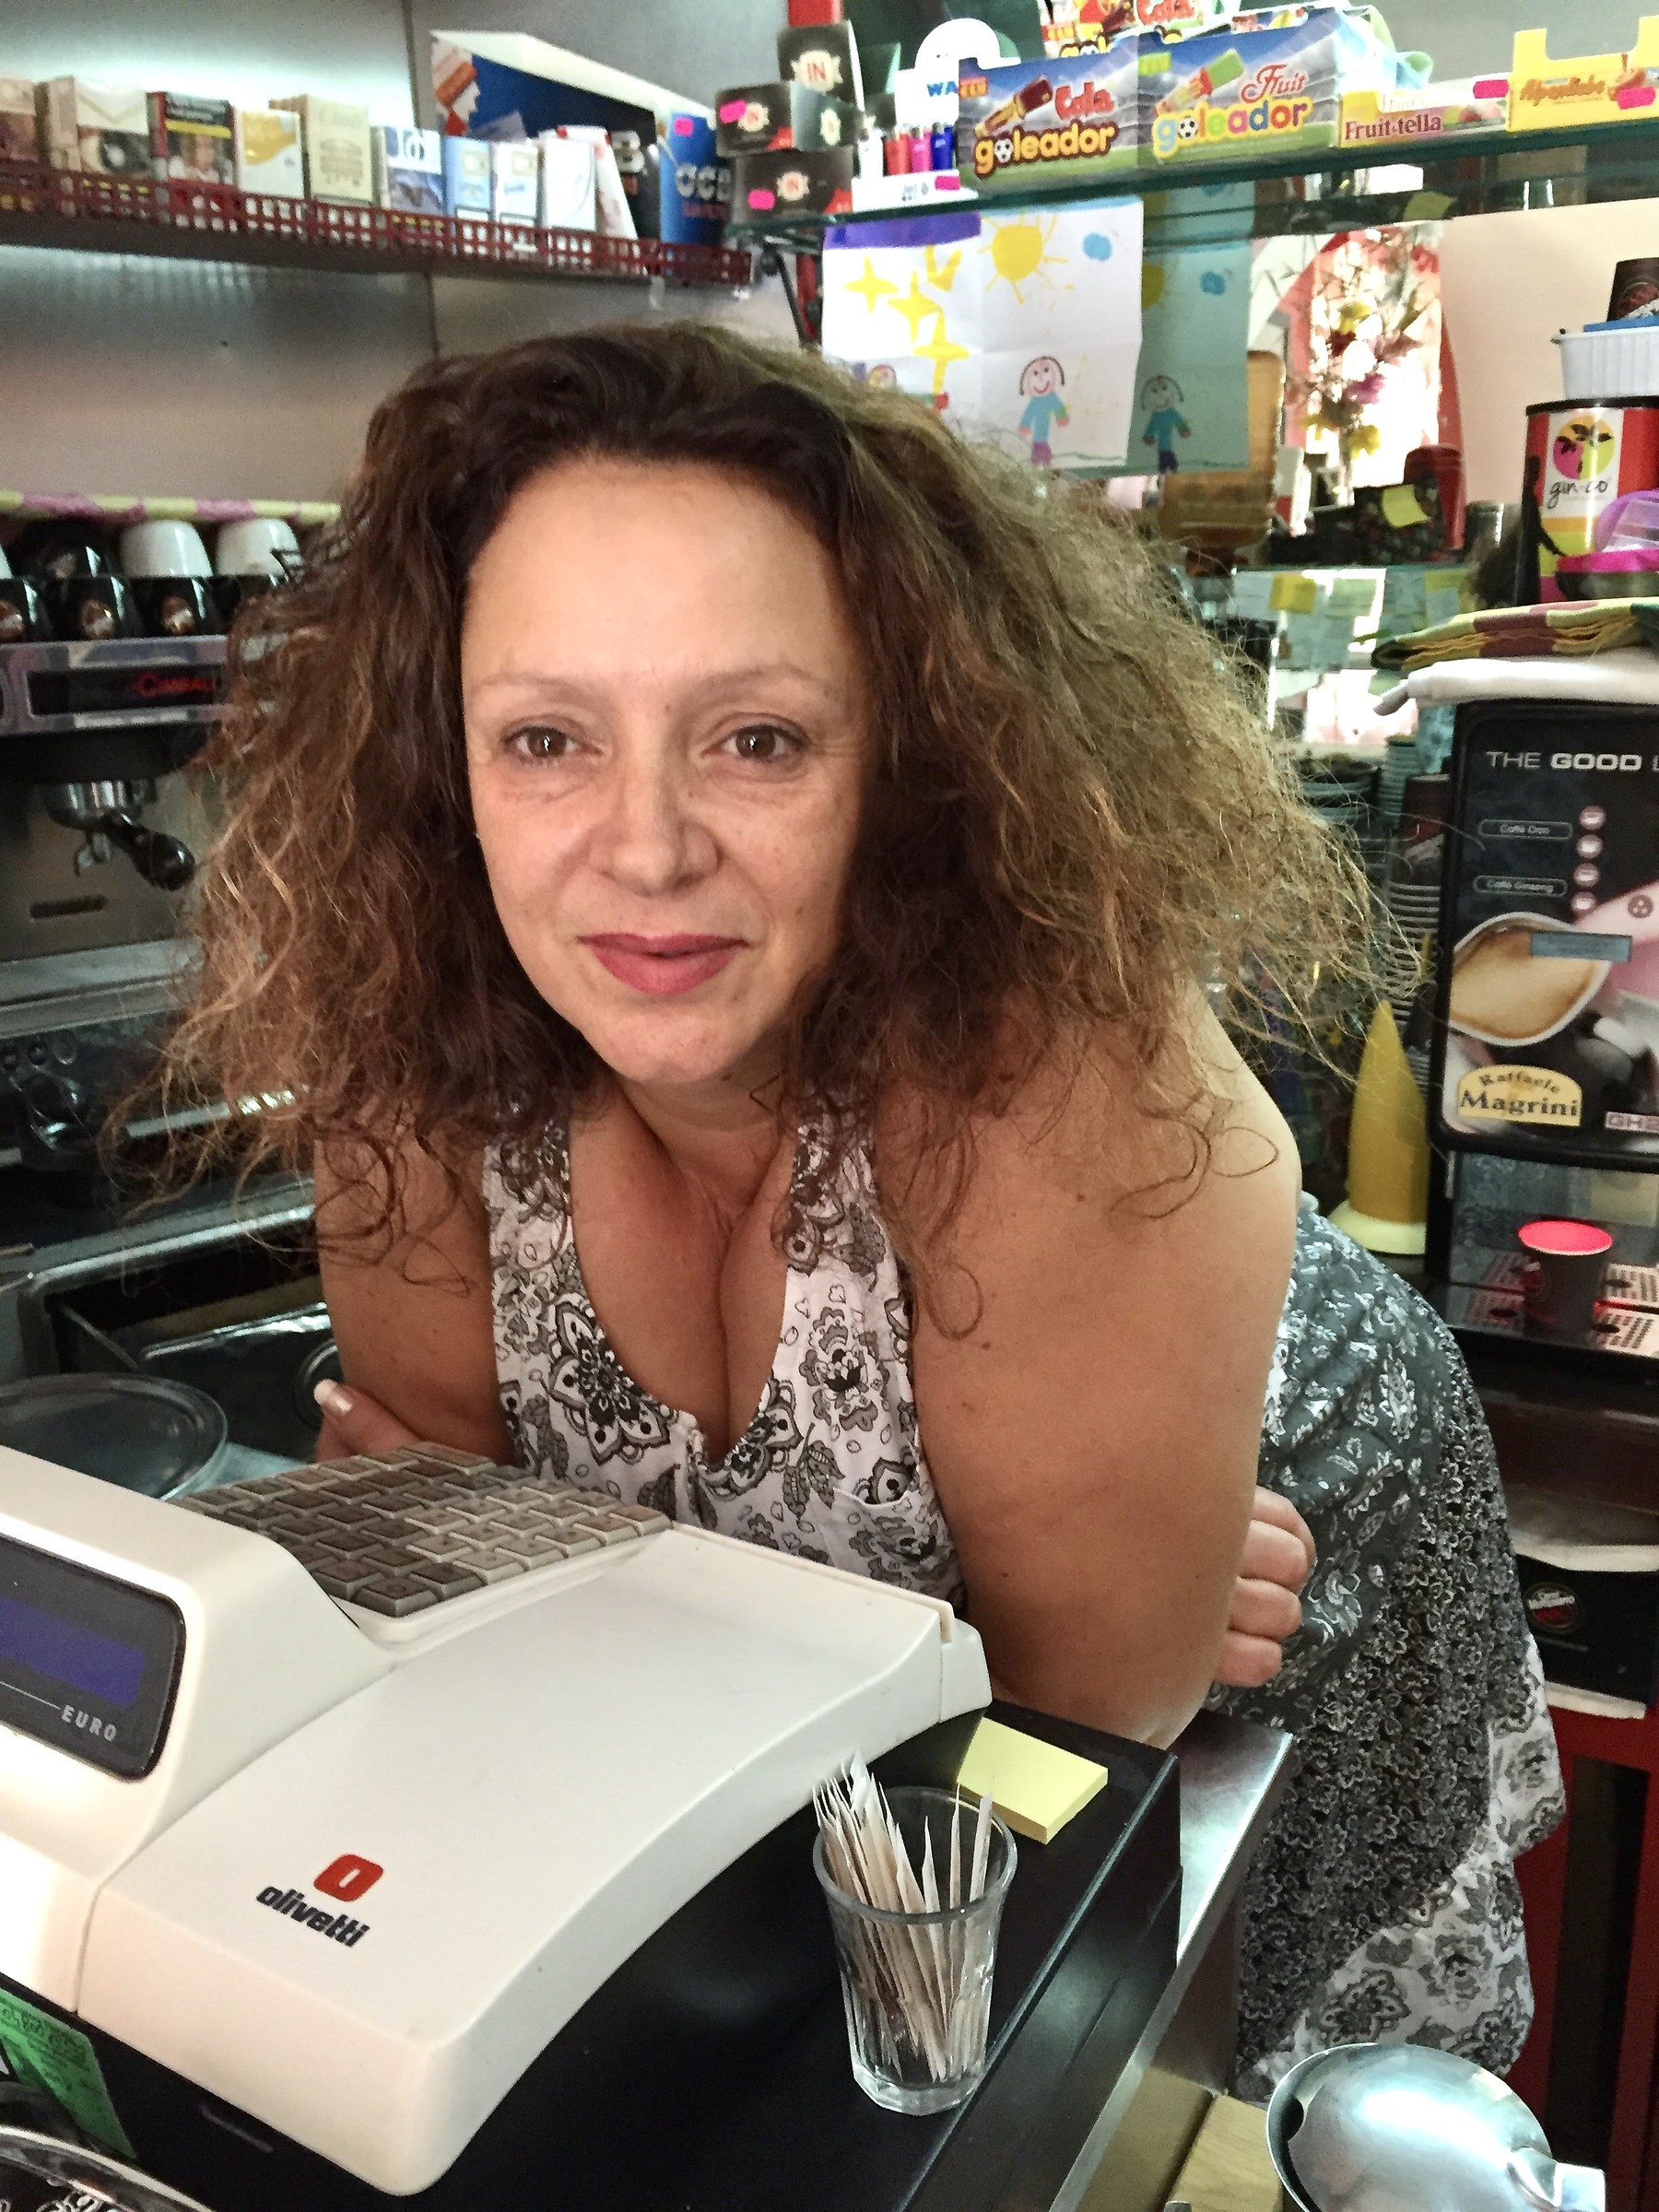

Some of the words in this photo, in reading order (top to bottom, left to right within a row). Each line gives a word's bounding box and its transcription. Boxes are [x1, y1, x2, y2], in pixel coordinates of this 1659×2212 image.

[806, 61, 827, 82] IN
[1241, 64, 1306, 104] Fruit
[1055, 81, 1114, 120] Cola
[1486, 750, 1541, 769] THE
[1550, 752, 1642, 772] GOOD
[1478, 1070, 1560, 1095] Raffaele
[1461, 1089, 1579, 1117] Magrini
[61, 1704, 117, 1742] EURO
[256, 1886, 371, 1947] olivetti
